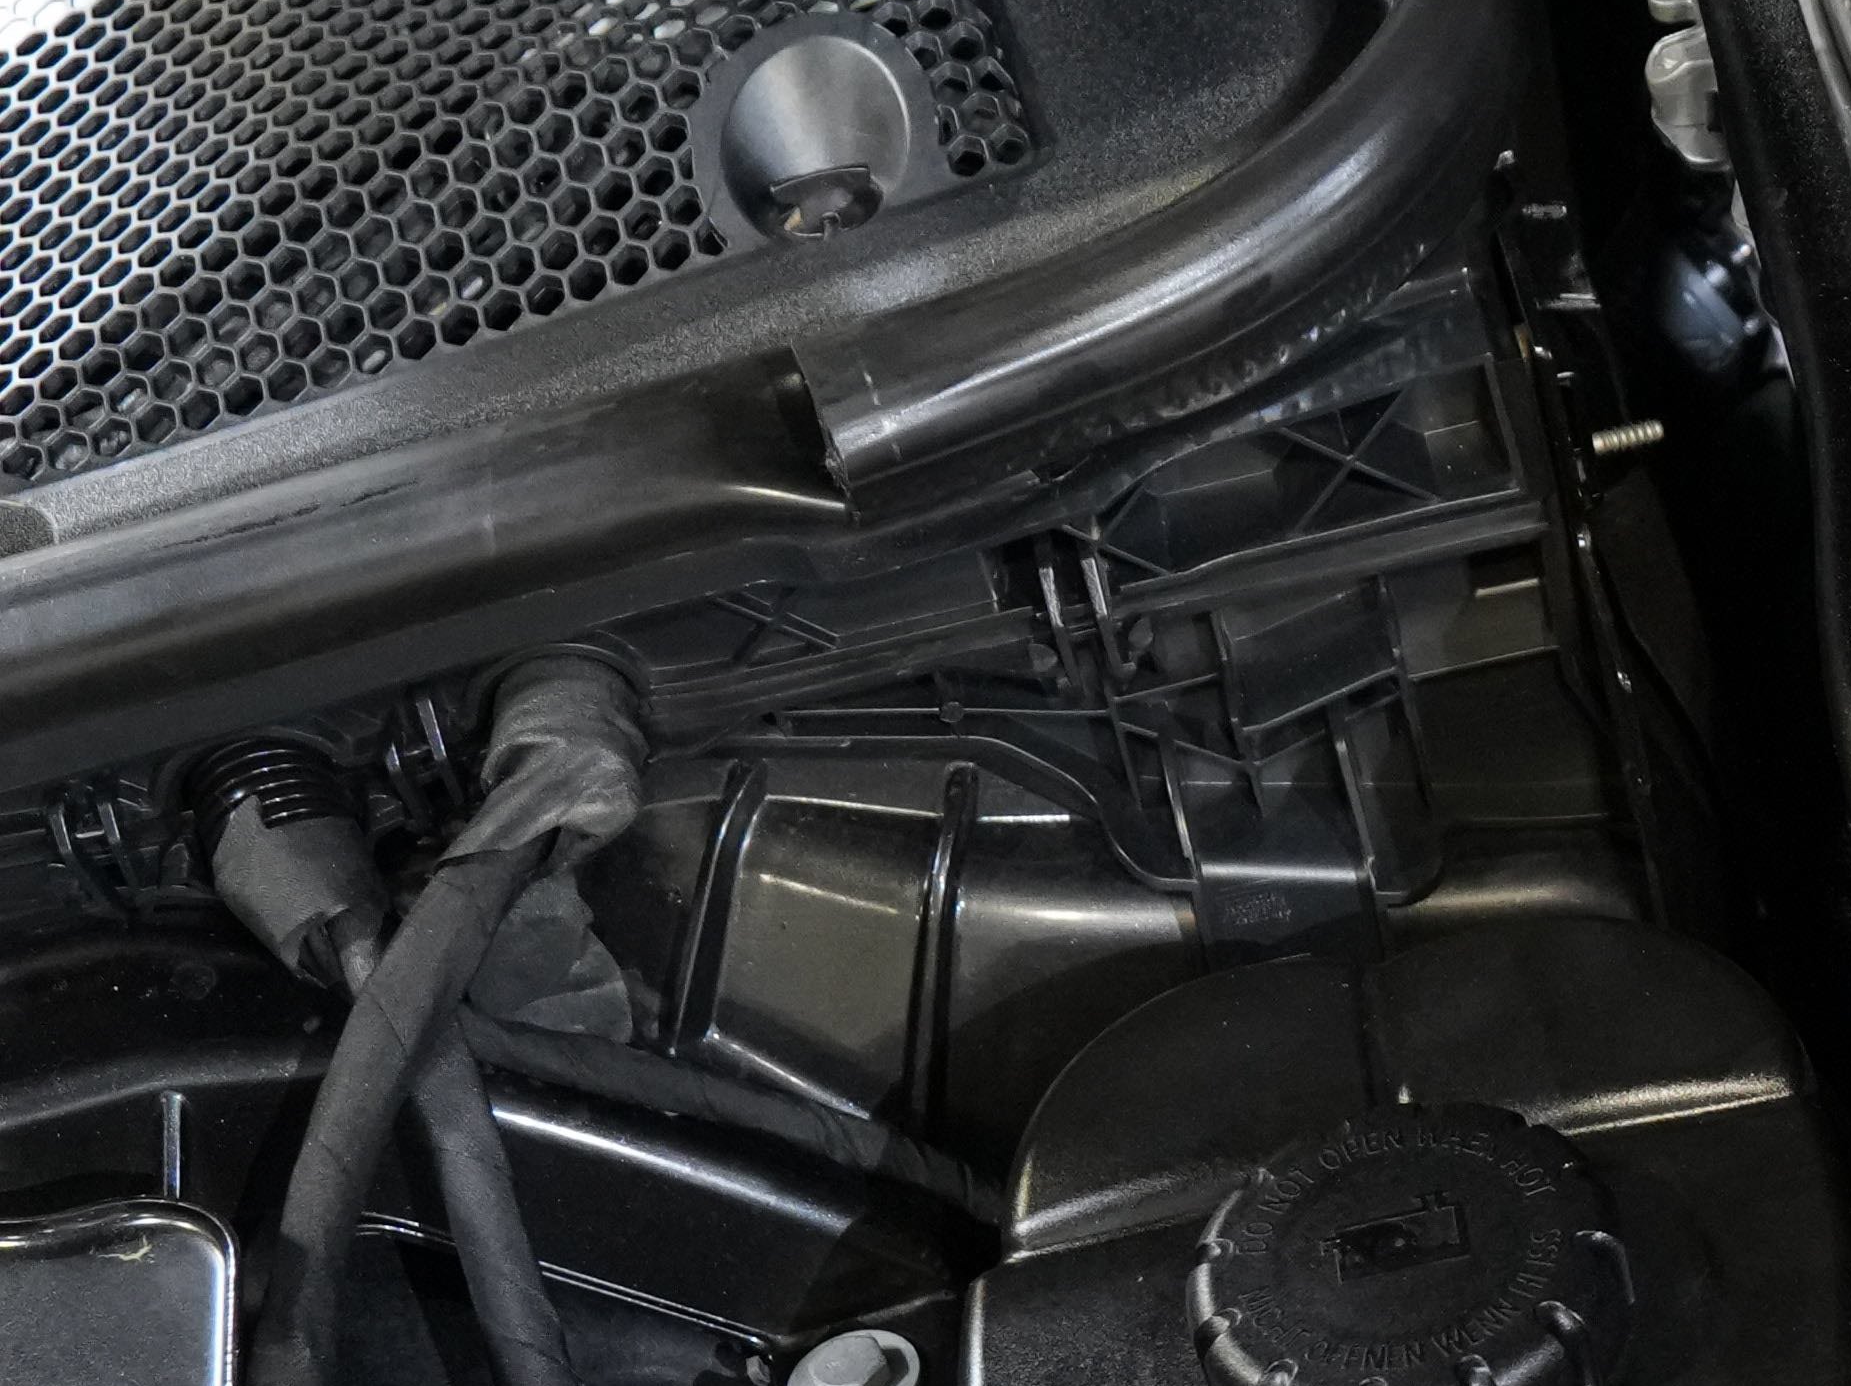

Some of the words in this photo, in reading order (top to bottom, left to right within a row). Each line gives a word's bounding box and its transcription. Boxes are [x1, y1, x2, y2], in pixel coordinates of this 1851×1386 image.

[1235, 1221, 1274, 1255] DO
[1257, 1165, 1314, 1213] NOT
[1318, 1130, 1405, 1170] OPEN
[1499, 1159, 1557, 1197] HOT
[1430, 1296, 1521, 1359] WENN
